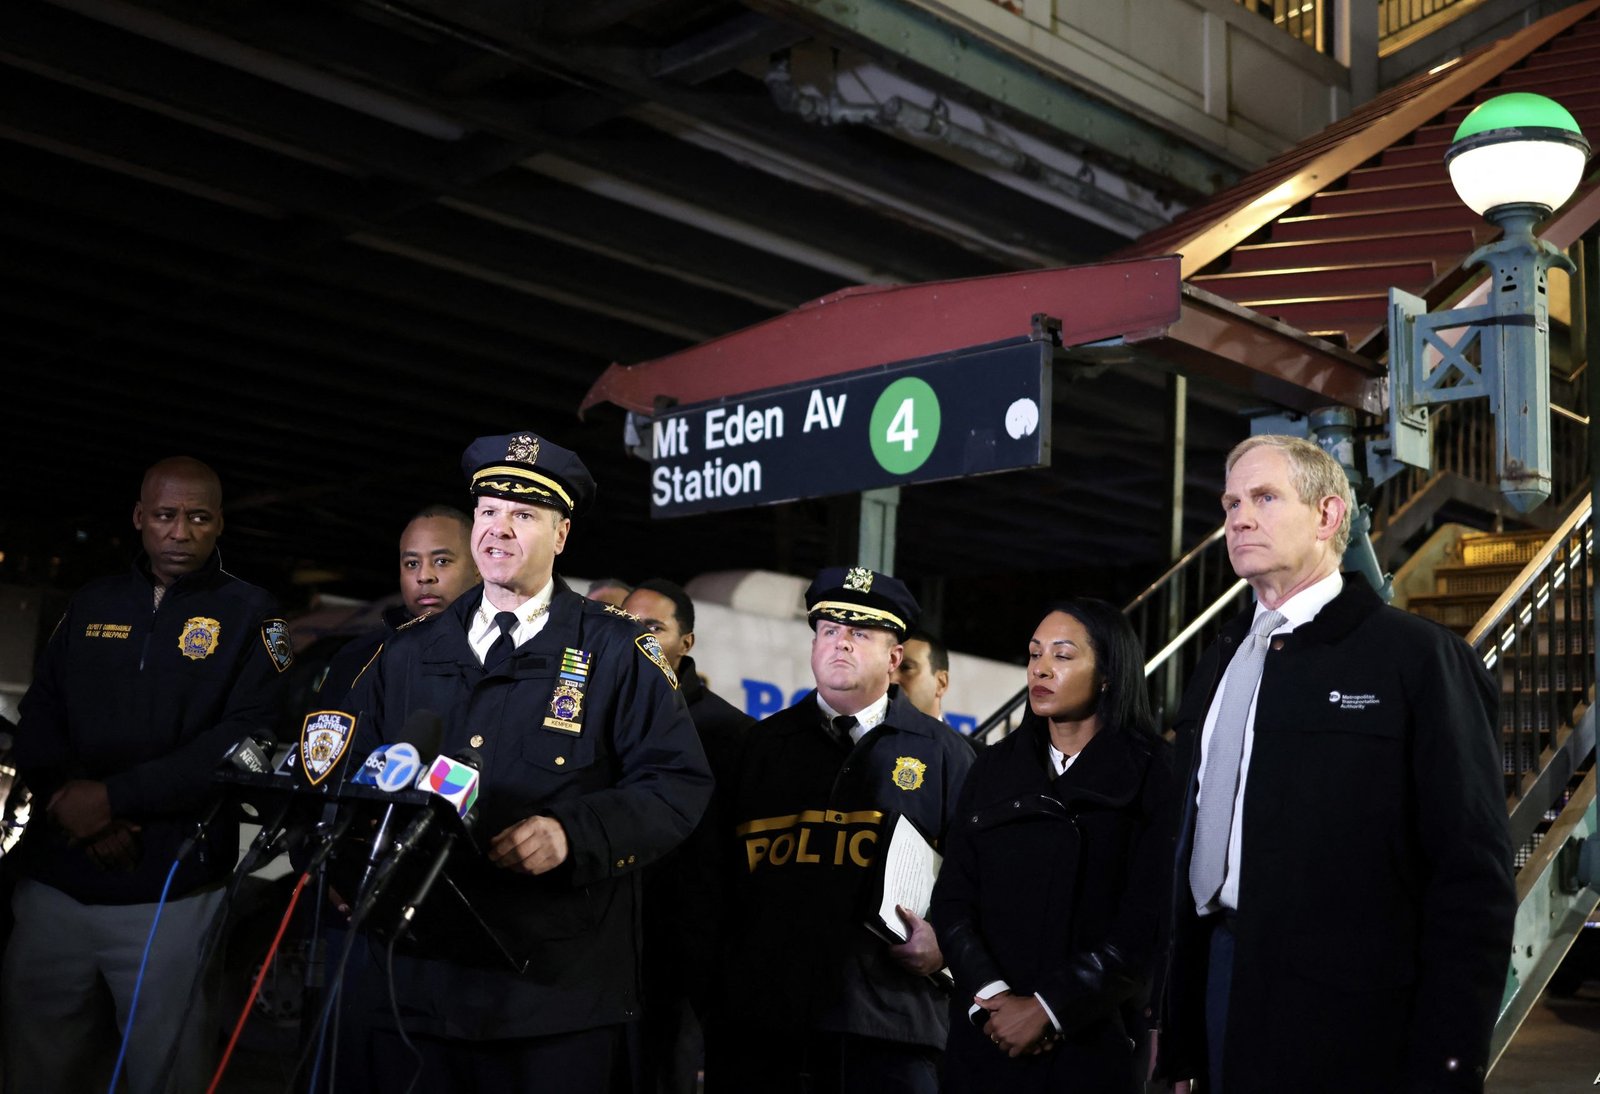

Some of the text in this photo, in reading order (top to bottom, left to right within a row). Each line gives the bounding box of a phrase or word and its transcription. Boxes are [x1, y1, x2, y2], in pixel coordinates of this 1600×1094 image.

[652, 389, 847, 460] Mt Eden Av
[886, 398, 919, 452] 4
[652, 458, 761, 507] Station
[306, 721, 348, 735] DEPARTMENT
[317, 714, 341, 724] POLICE
[551, 720, 573, 729] KEMPER
[365, 756, 386, 770] abc
[745, 828, 879, 873] POLIC
